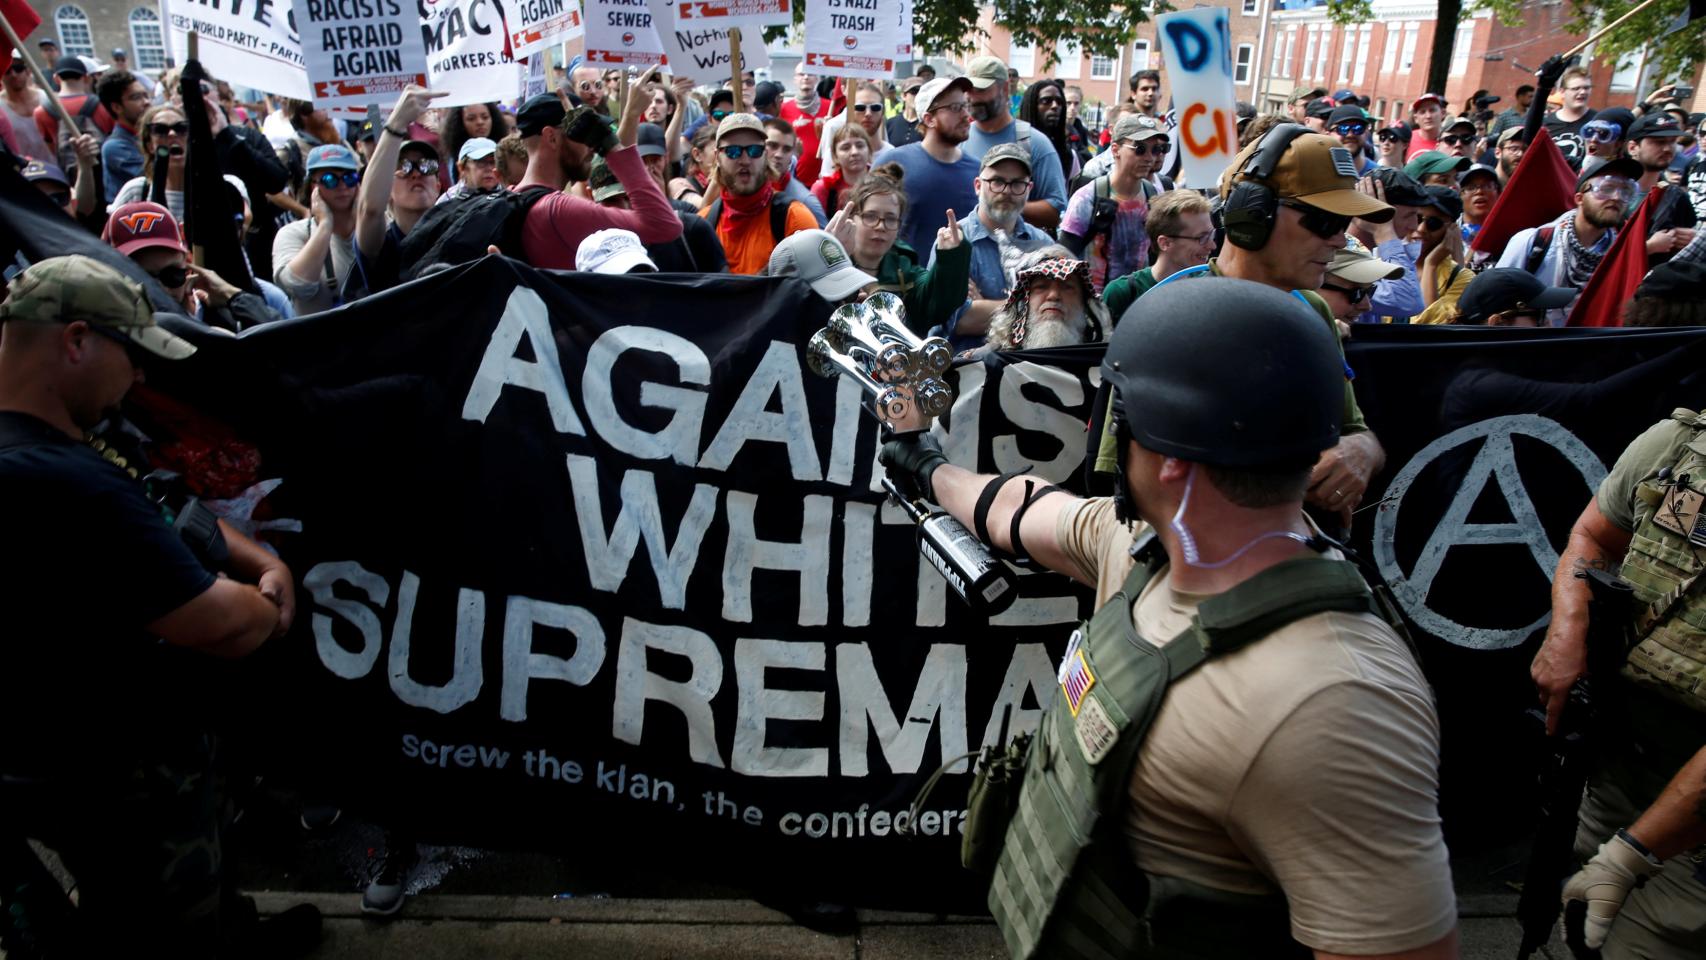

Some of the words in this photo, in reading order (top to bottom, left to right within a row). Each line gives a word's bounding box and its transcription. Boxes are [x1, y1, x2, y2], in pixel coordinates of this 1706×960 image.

[307, 0, 401, 22] RACISTS
[521, 0, 563, 26] AGAIN
[608, 11, 652, 28] SEWER
[831, 14, 875, 31] TRASH
[192, 18, 224, 39] WORLD
[226, 28, 259, 49] PARTY
[270, 42, 305, 66] PARTI
[322, 22, 403, 51] AFRAID
[333, 49, 403, 77] AGAIN
[693, 50, 746, 71] Wrog
[119, 212, 164, 234] VT
[462, 286, 1100, 492] AGAINS
[401, 733, 511, 768] screw
[520, 748, 574, 784] the
[702, 789, 764, 827] the
